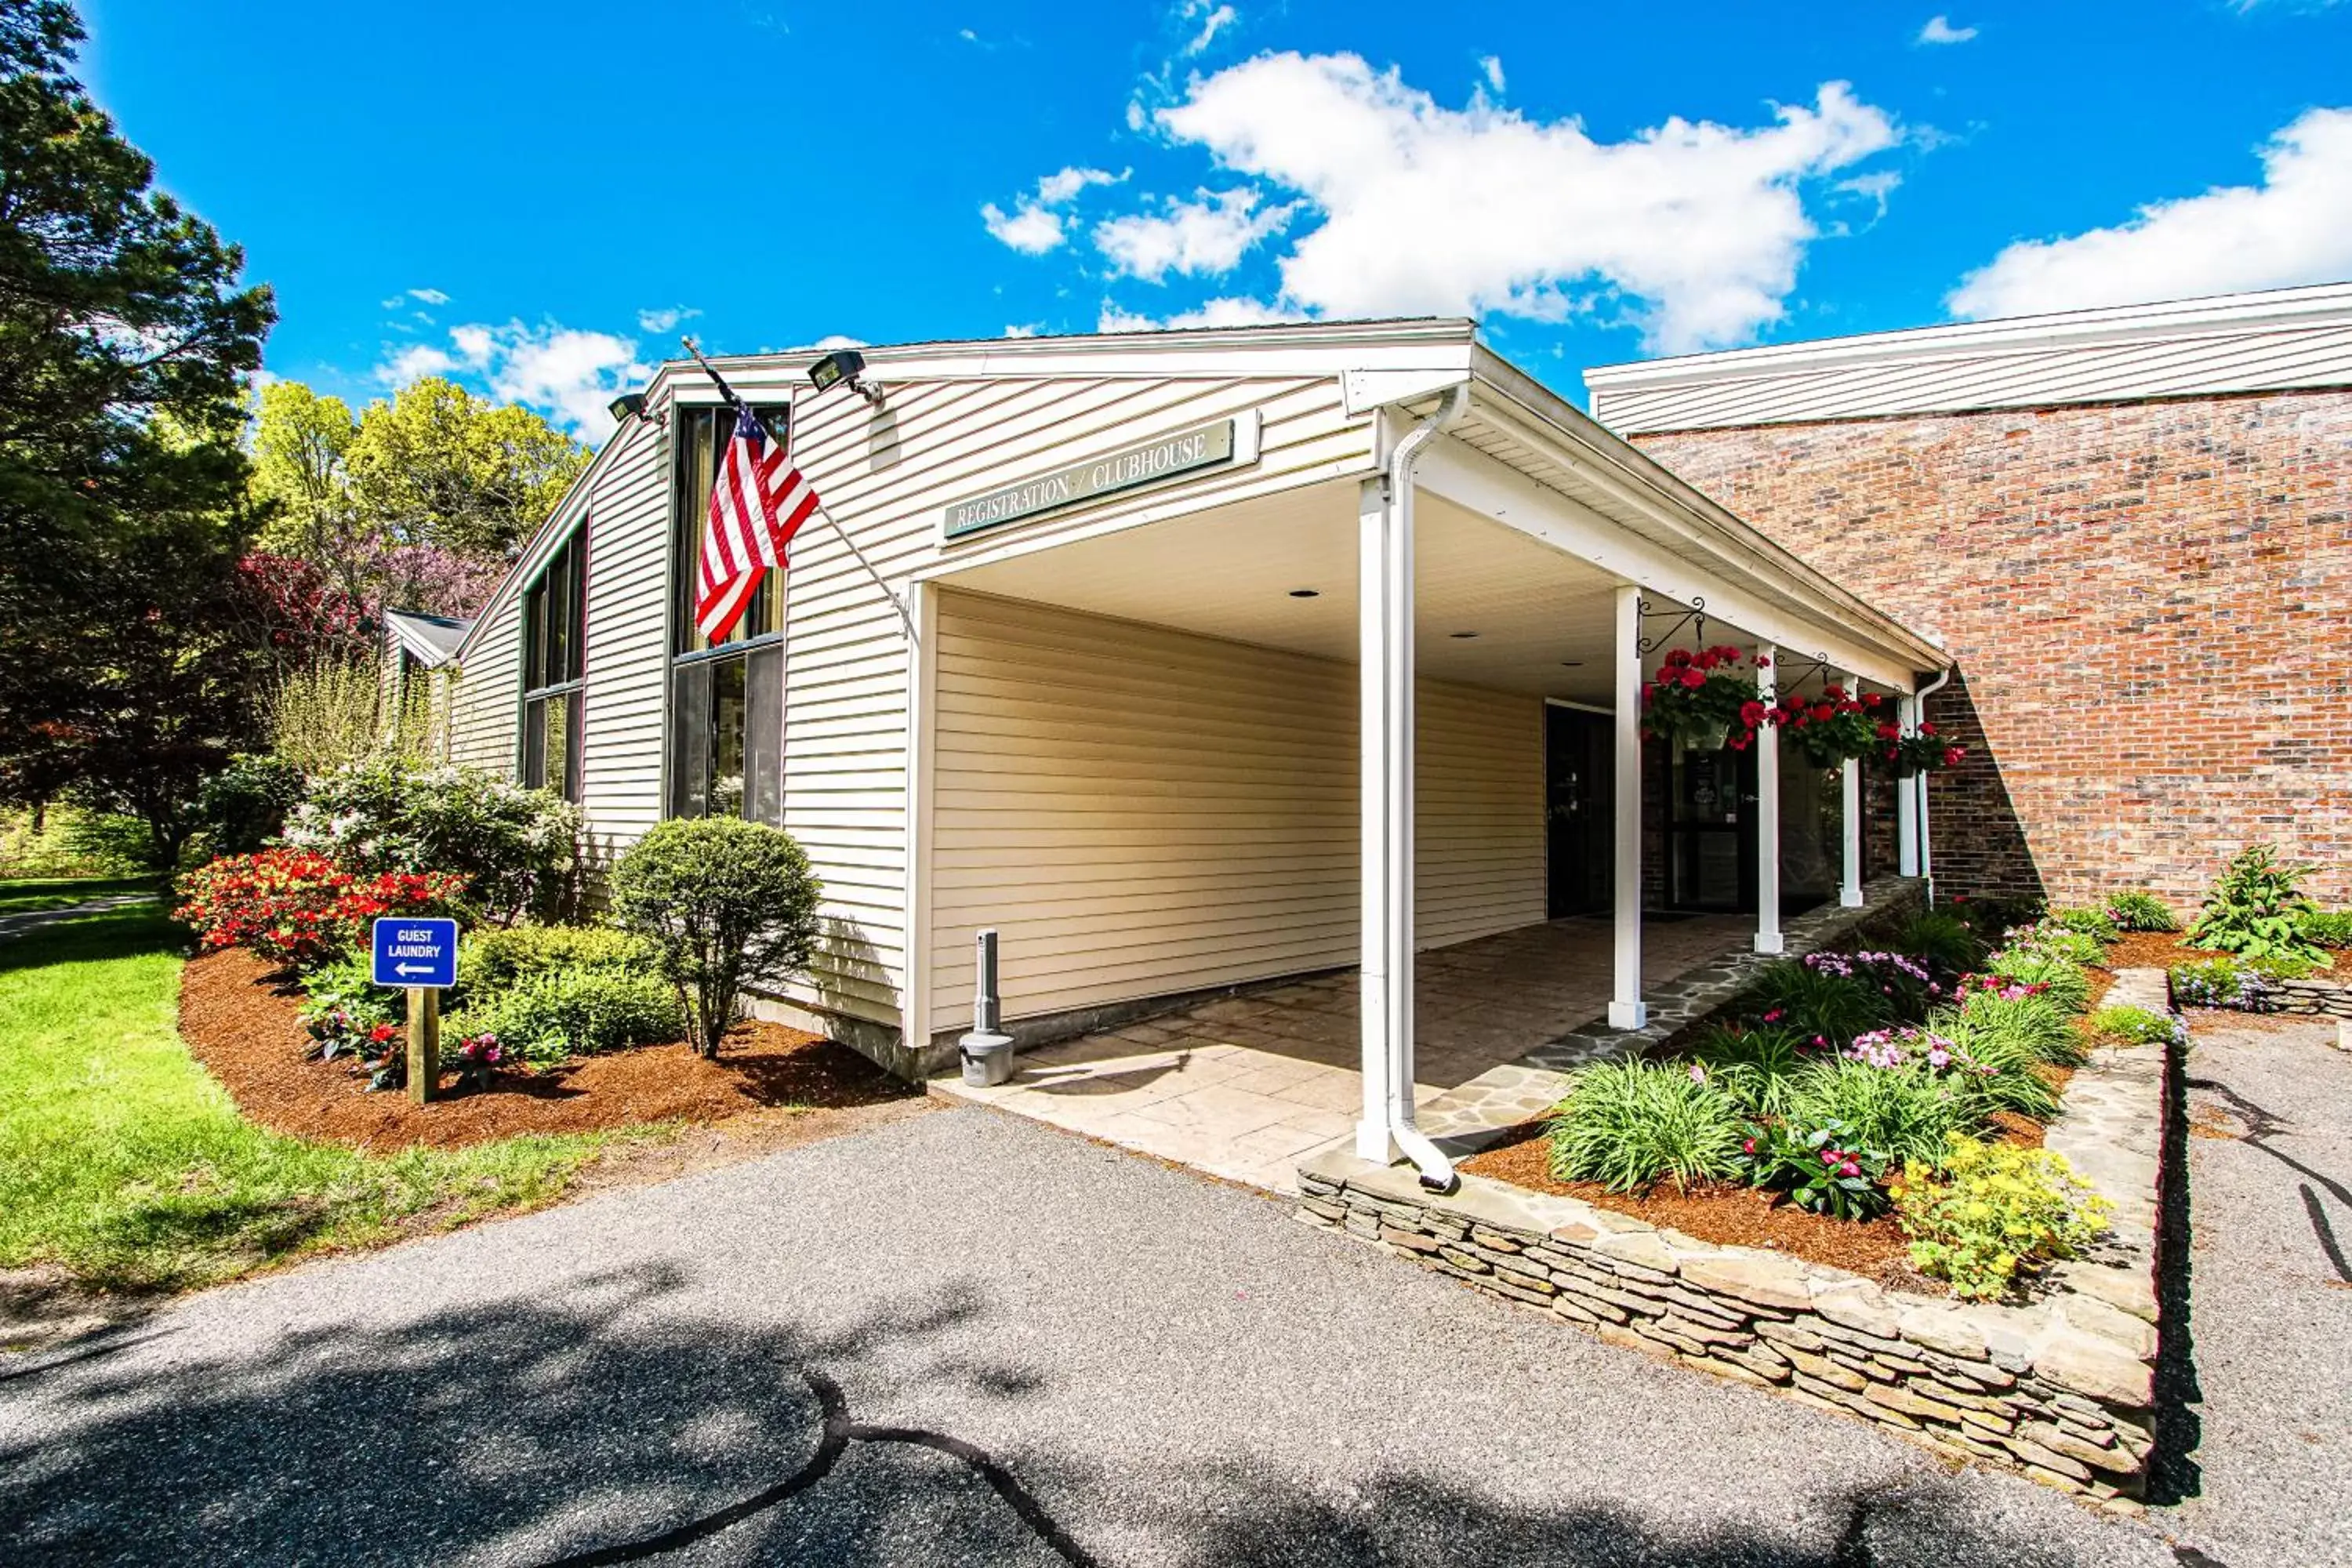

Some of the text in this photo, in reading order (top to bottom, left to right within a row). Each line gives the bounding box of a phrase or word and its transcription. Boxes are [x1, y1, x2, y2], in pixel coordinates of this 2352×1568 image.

[956, 475, 1069, 528] REGISTRATION
[1092, 434, 1207, 488] CLUBHOUSE
[397, 929, 434, 942] GUEST
[388, 945, 441, 958] LAUNDRY
